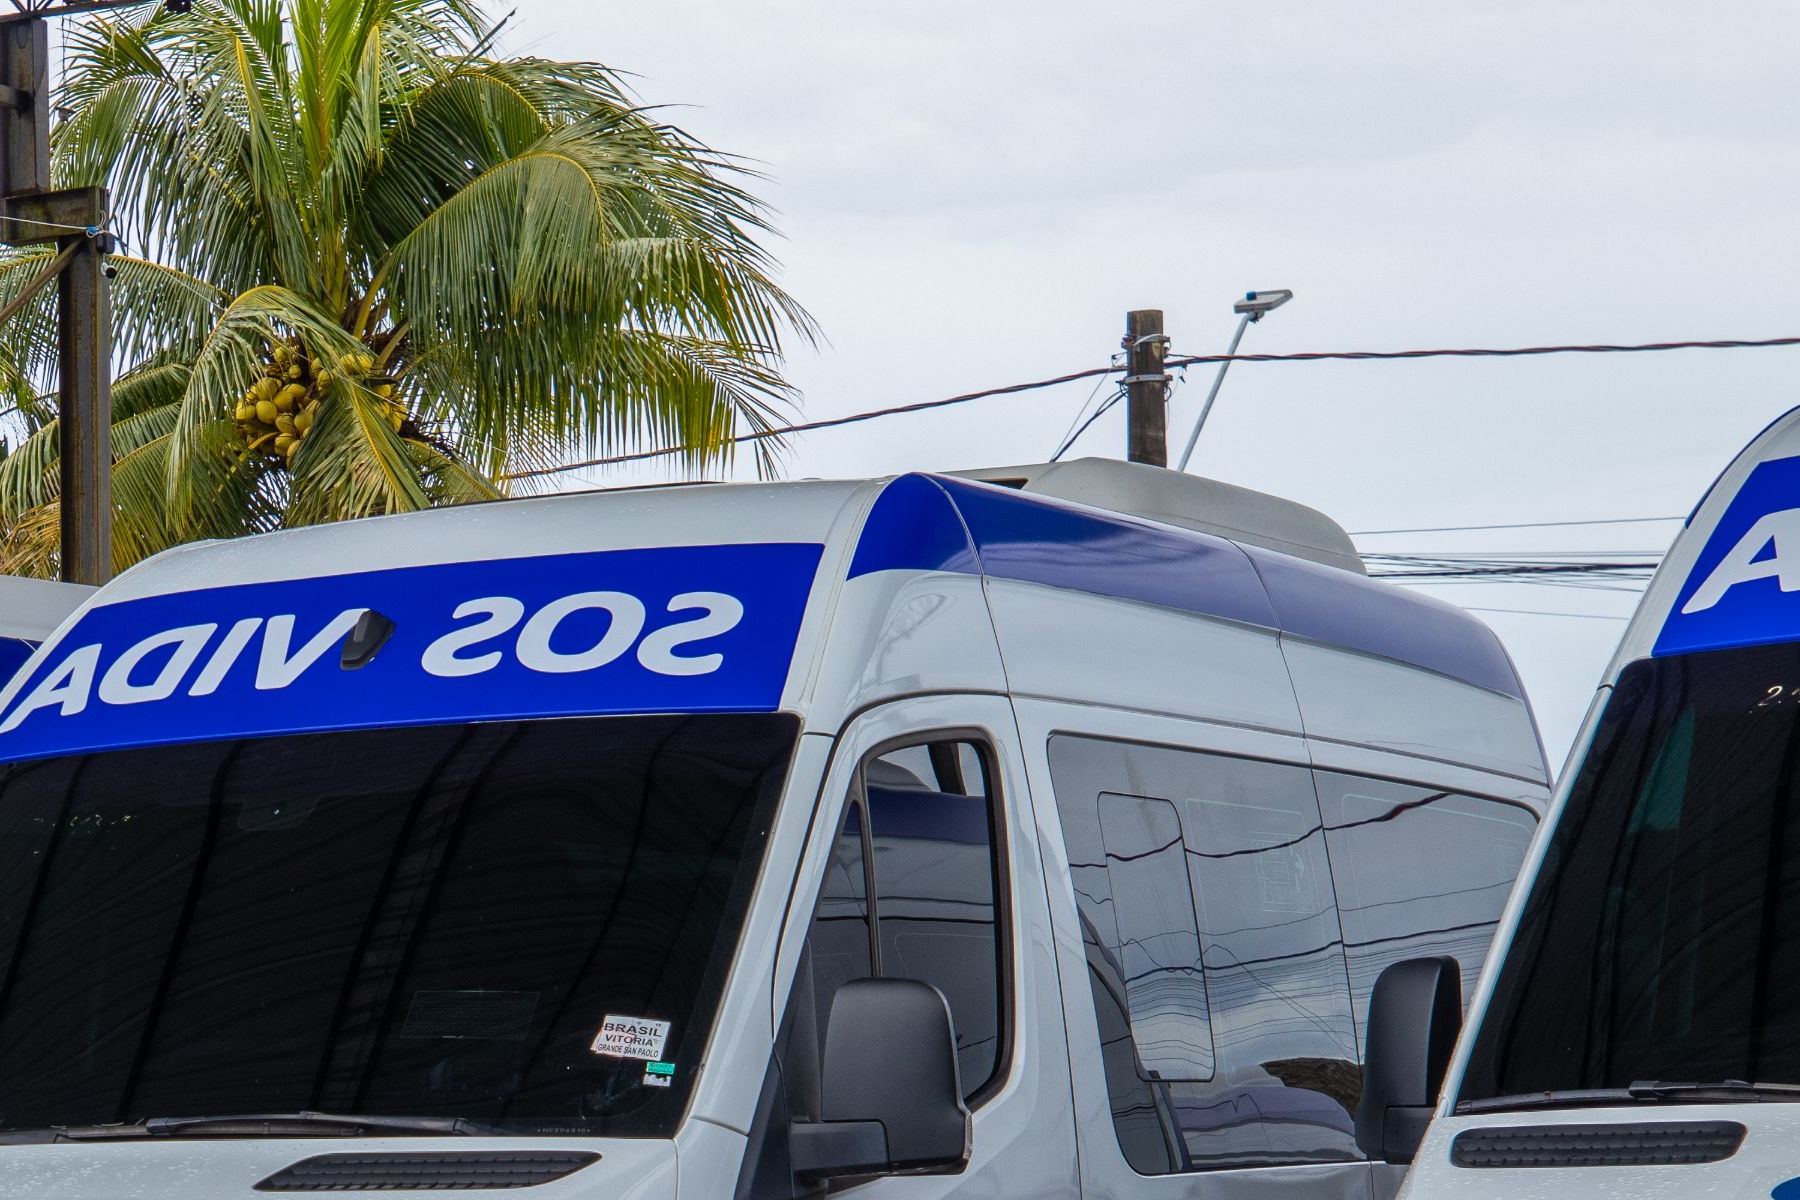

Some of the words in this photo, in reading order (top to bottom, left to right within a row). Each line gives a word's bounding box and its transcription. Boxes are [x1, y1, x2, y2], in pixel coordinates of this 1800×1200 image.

[604, 1022, 662, 1037] BRASIL
[605, 1033, 654, 1047] VITORIA
[597, 1043, 624, 1054] GRANDE
[624, 1046, 638, 1055] SAN
[637, 1048, 659, 1058] PAOLO
